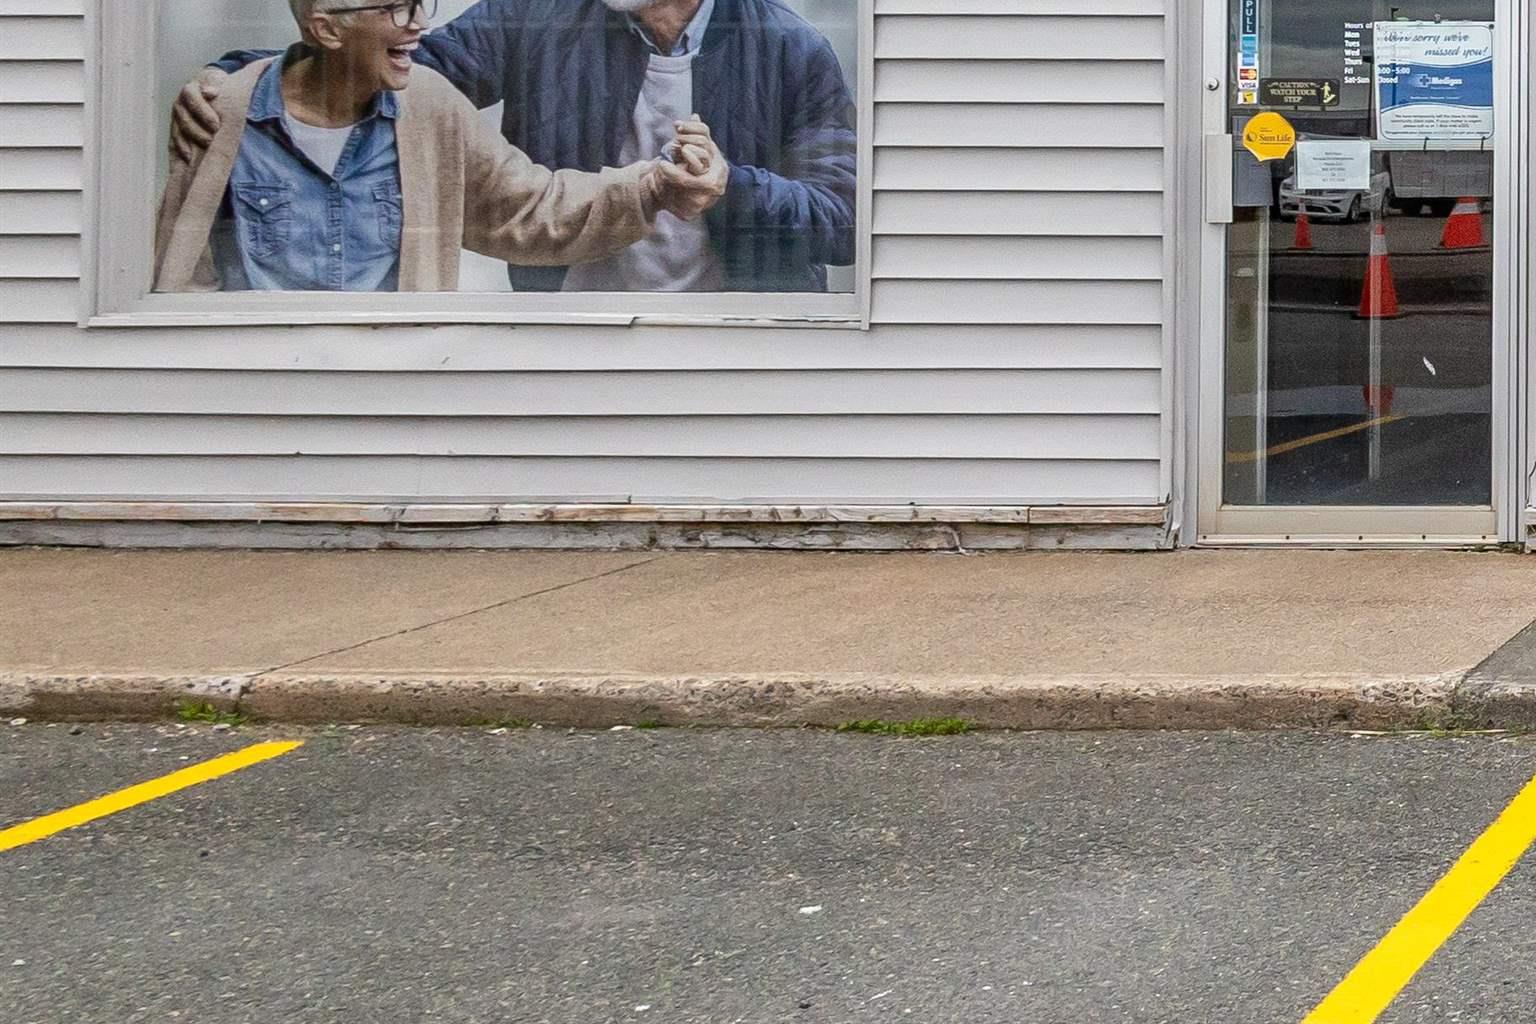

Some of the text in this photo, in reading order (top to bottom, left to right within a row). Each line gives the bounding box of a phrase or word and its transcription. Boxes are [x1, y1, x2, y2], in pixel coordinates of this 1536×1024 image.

[1245, 0, 1254, 33] PULL
[1344, 31, 1360, 39] Mon
[1344, 40, 1360, 48] Tues
[1411, 35, 1440, 45] sorry
[1424, 46, 1489, 58] missed you!
[1344, 67, 1354, 75] Fri
